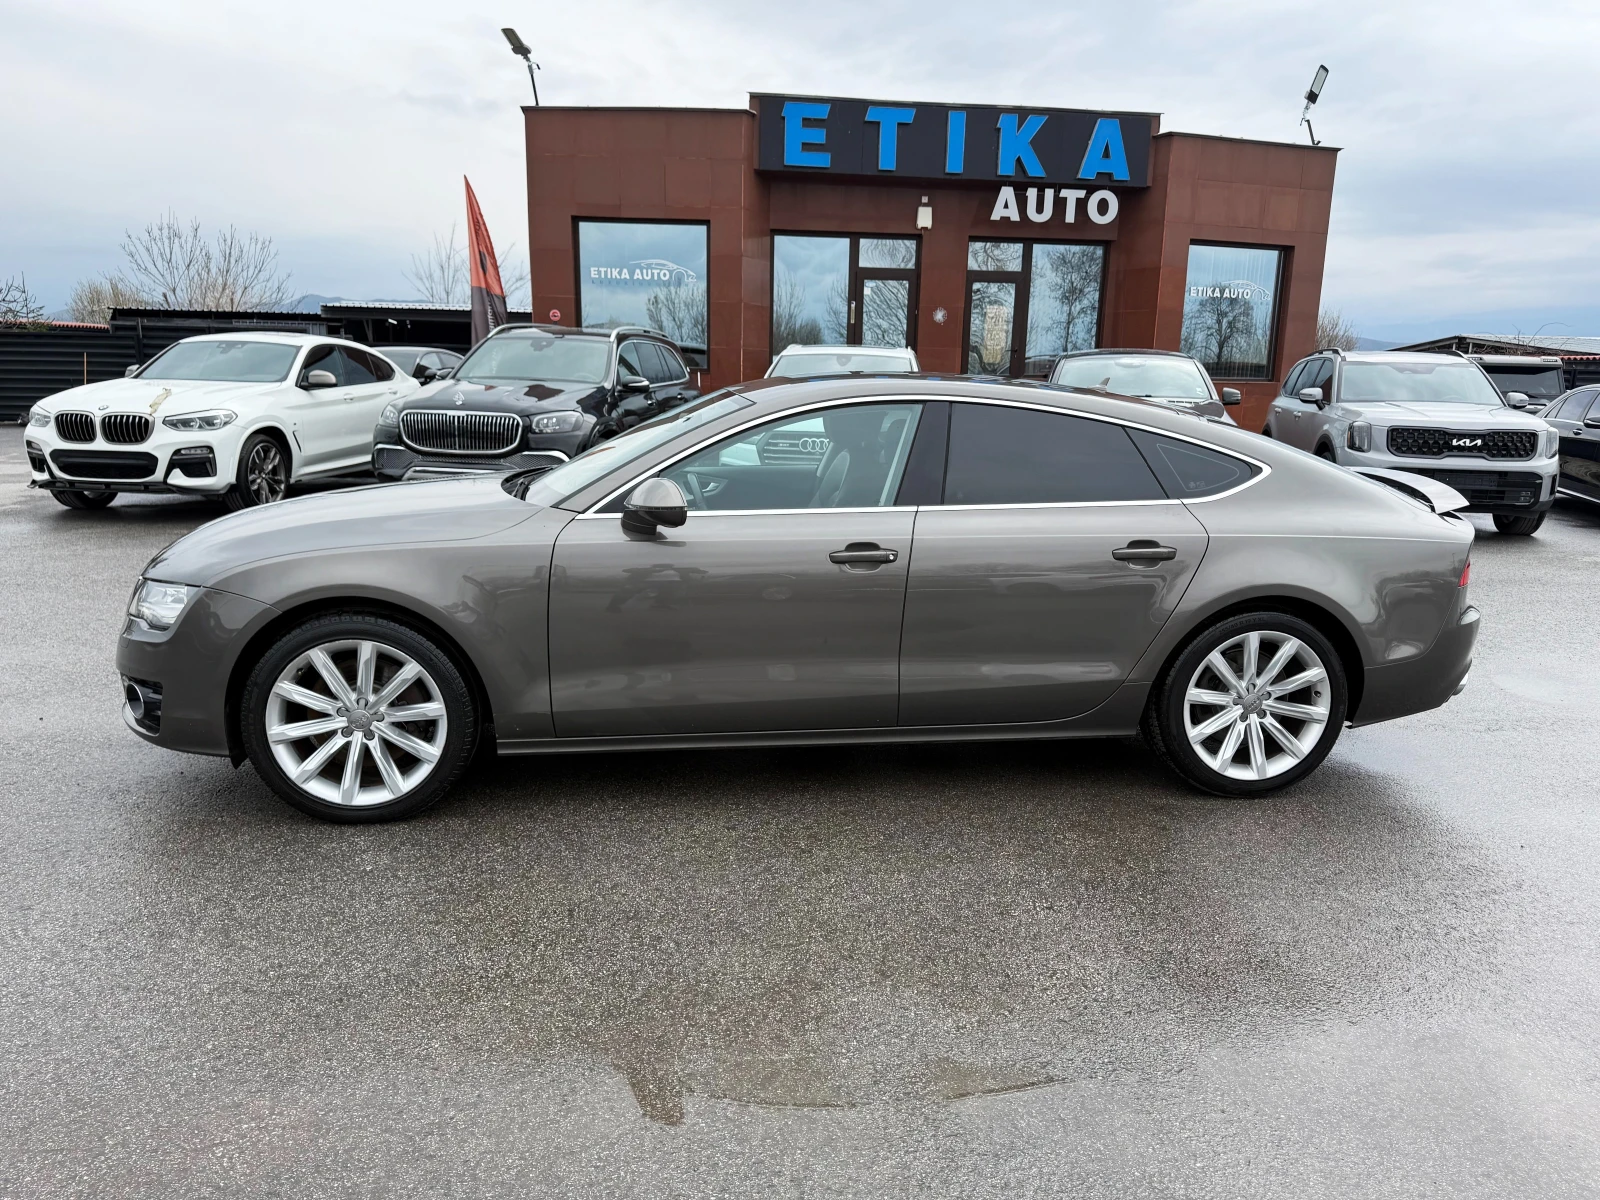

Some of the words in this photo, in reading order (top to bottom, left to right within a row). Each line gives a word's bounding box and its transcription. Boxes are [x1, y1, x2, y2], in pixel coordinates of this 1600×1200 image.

[781, 101, 1130, 181] ETIKA
[990, 186, 1119, 225] AUTO
[590, 267, 630, 279] ETIKA
[634, 269, 670, 281] AUTO
[1190, 286, 1220, 298] ETIKA
[1223, 288, 1251, 299] AUTO
